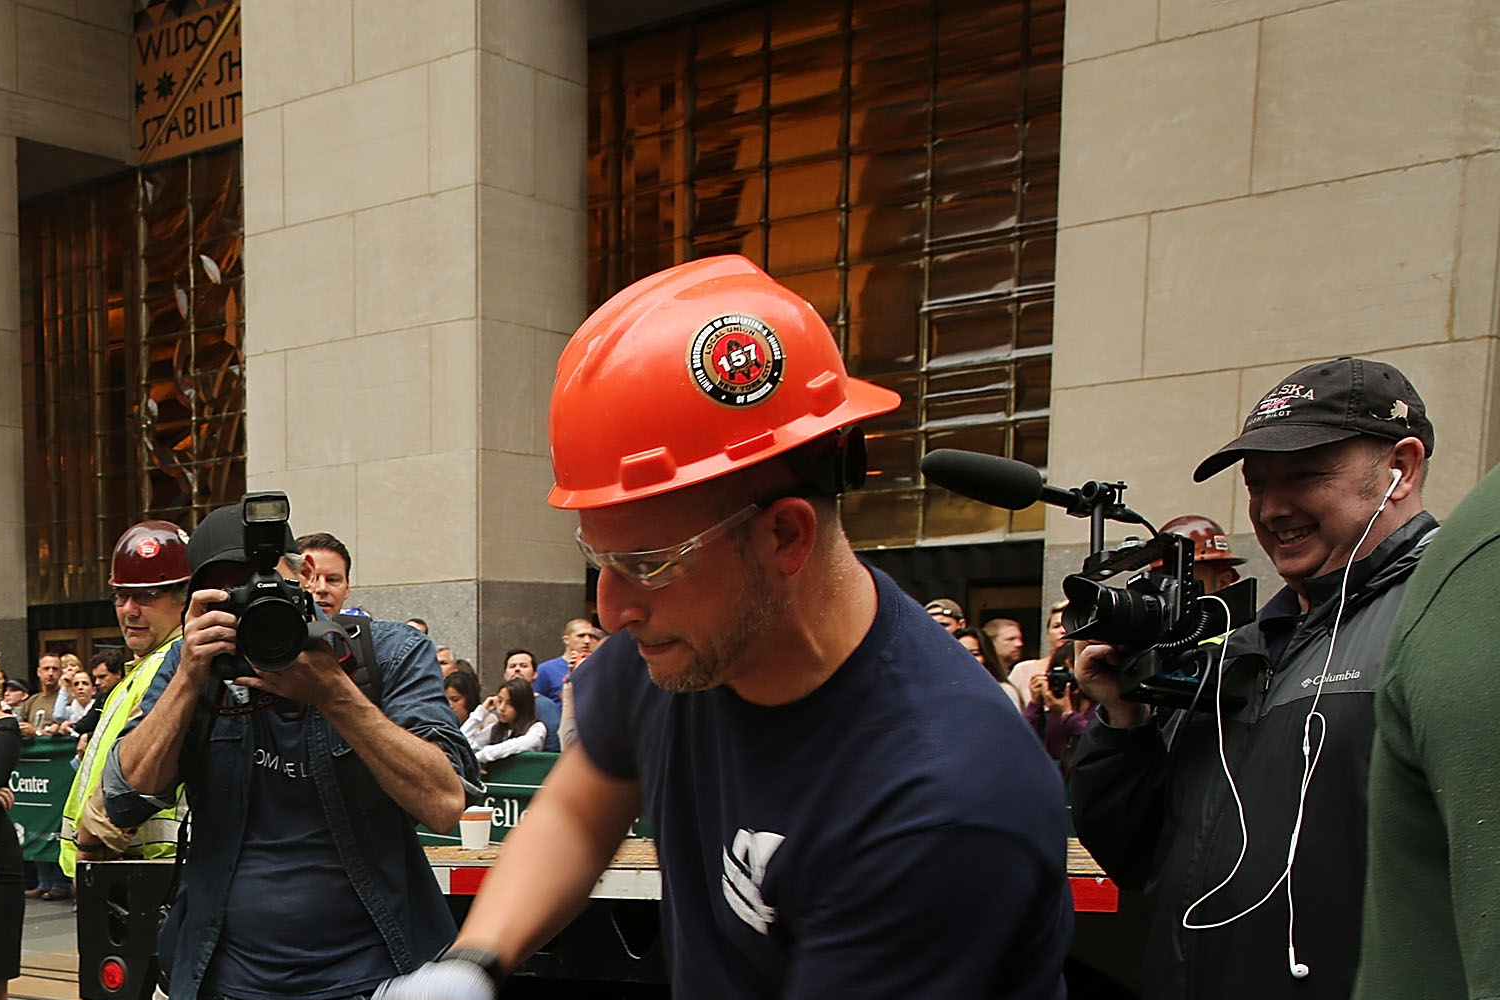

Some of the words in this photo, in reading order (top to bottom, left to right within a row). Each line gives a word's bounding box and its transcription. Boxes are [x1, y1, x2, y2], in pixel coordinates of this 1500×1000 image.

[137, 11, 240, 66] WISDO
[718, 343, 757, 372] 157
[8, 771, 49, 793] Center
